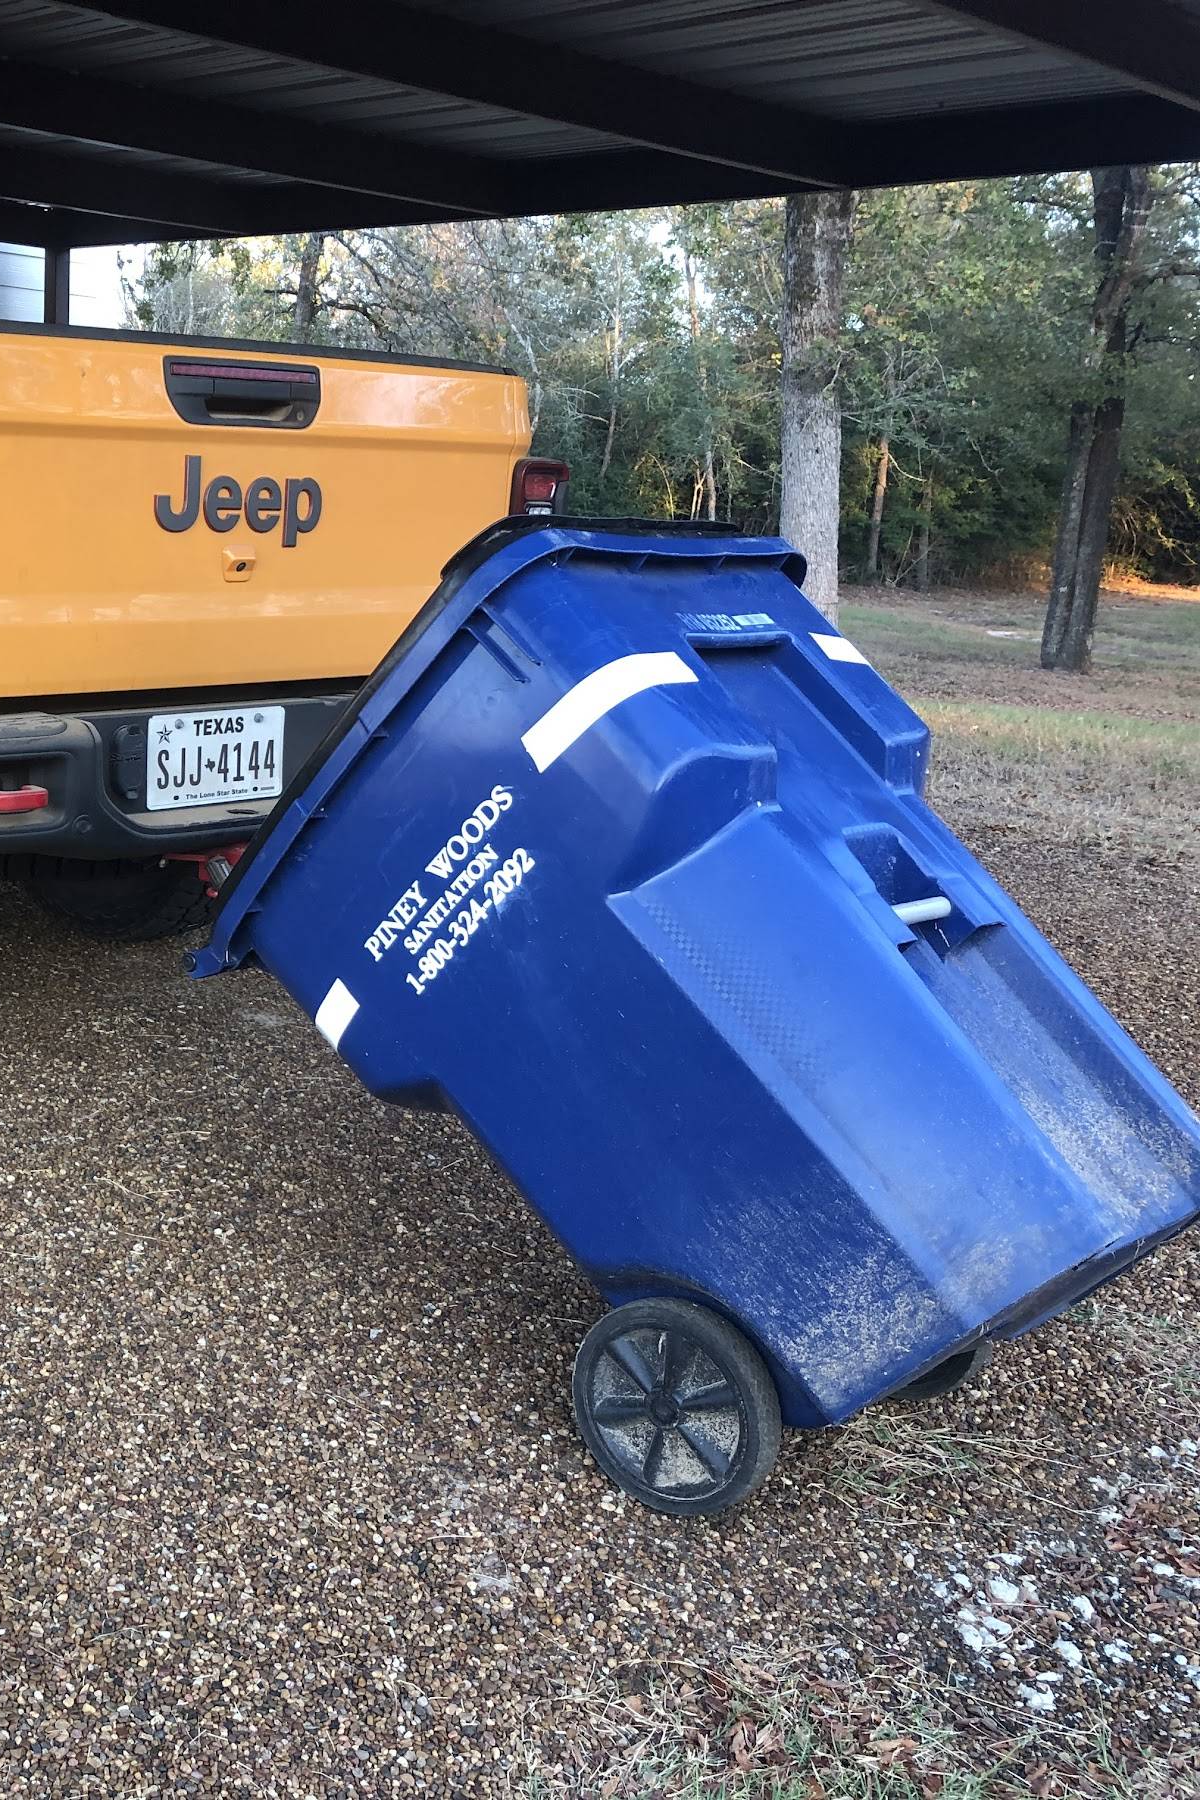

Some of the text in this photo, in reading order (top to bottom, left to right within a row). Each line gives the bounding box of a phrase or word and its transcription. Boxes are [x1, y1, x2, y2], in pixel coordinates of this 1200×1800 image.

[154, 455, 322, 548] Jeep
[156, 739, 275, 790] SJJ 4144
[193, 716, 244, 737] TEXAS
[363, 784, 513, 962] PINEY WOODS
[403, 843, 499, 956] SANITATION
[405, 847, 536, 995] 1-800-324-2092
